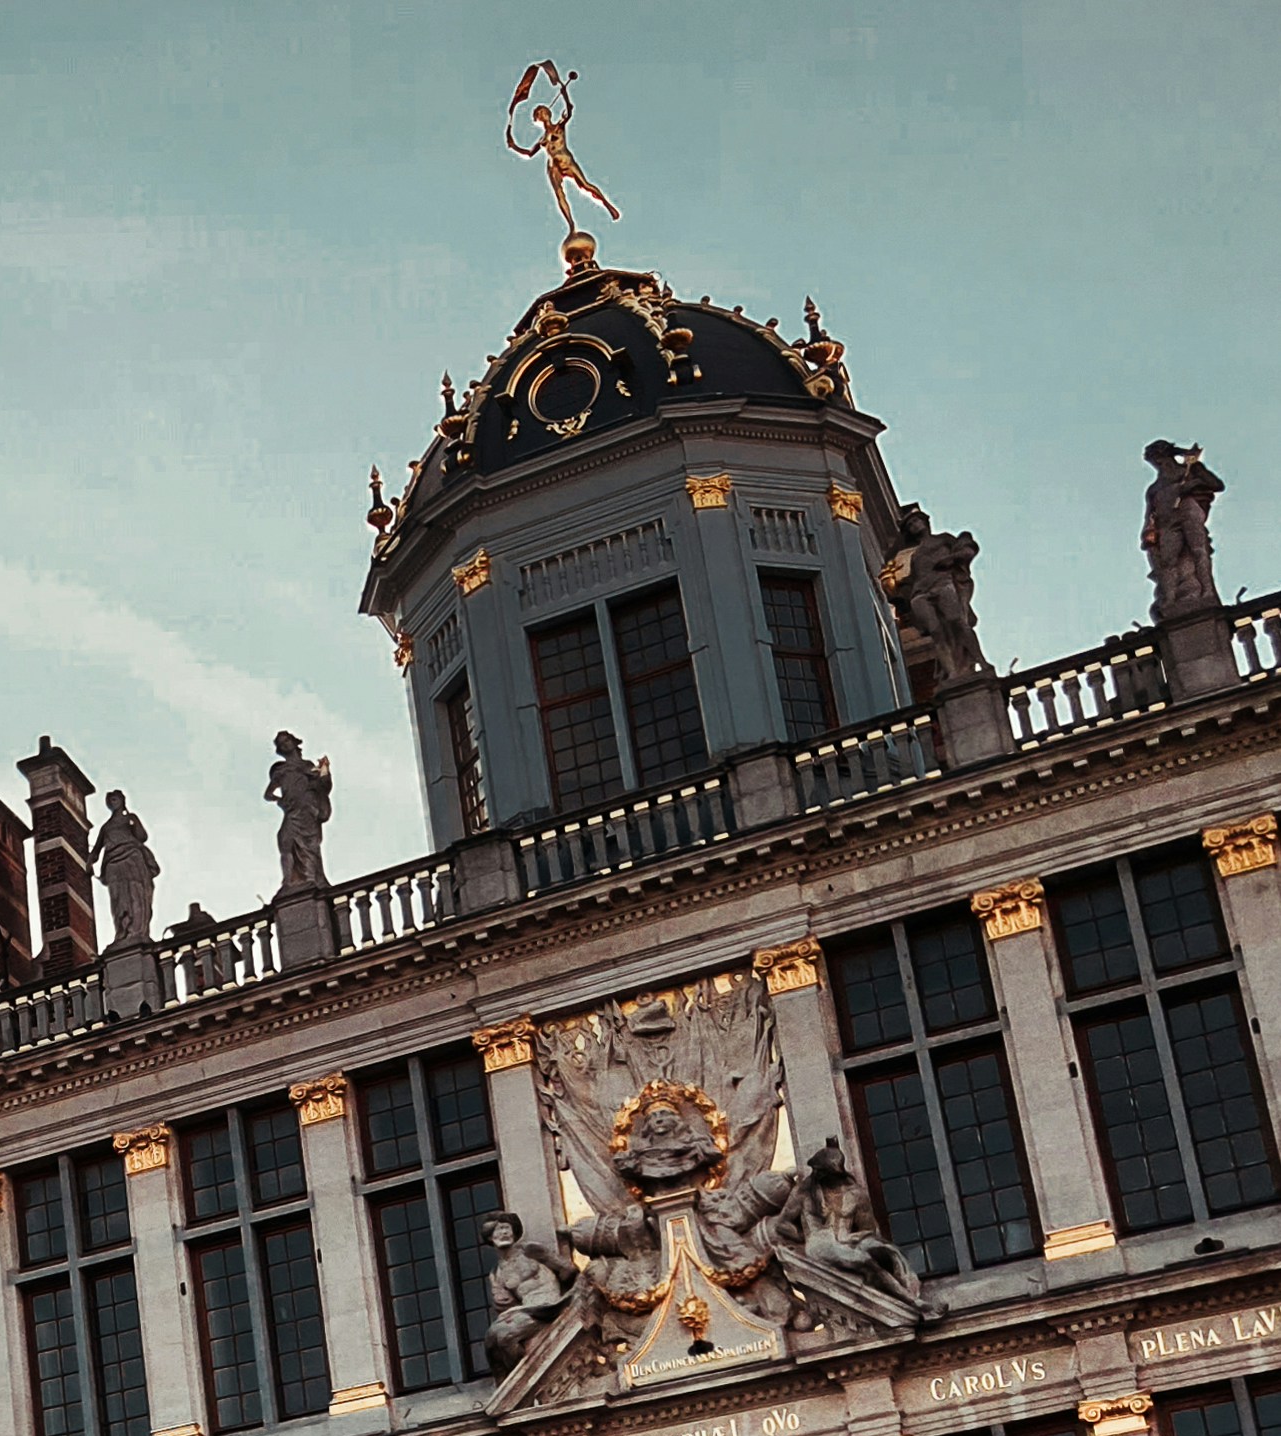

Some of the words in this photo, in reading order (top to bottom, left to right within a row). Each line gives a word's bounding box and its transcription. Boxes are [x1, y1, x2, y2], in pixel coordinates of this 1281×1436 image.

[929, 1359, 1047, 1401] CAROLVS
[1140, 1329, 1222, 1360] PLENA
[1231, 1307, 1281, 1342] LAV
